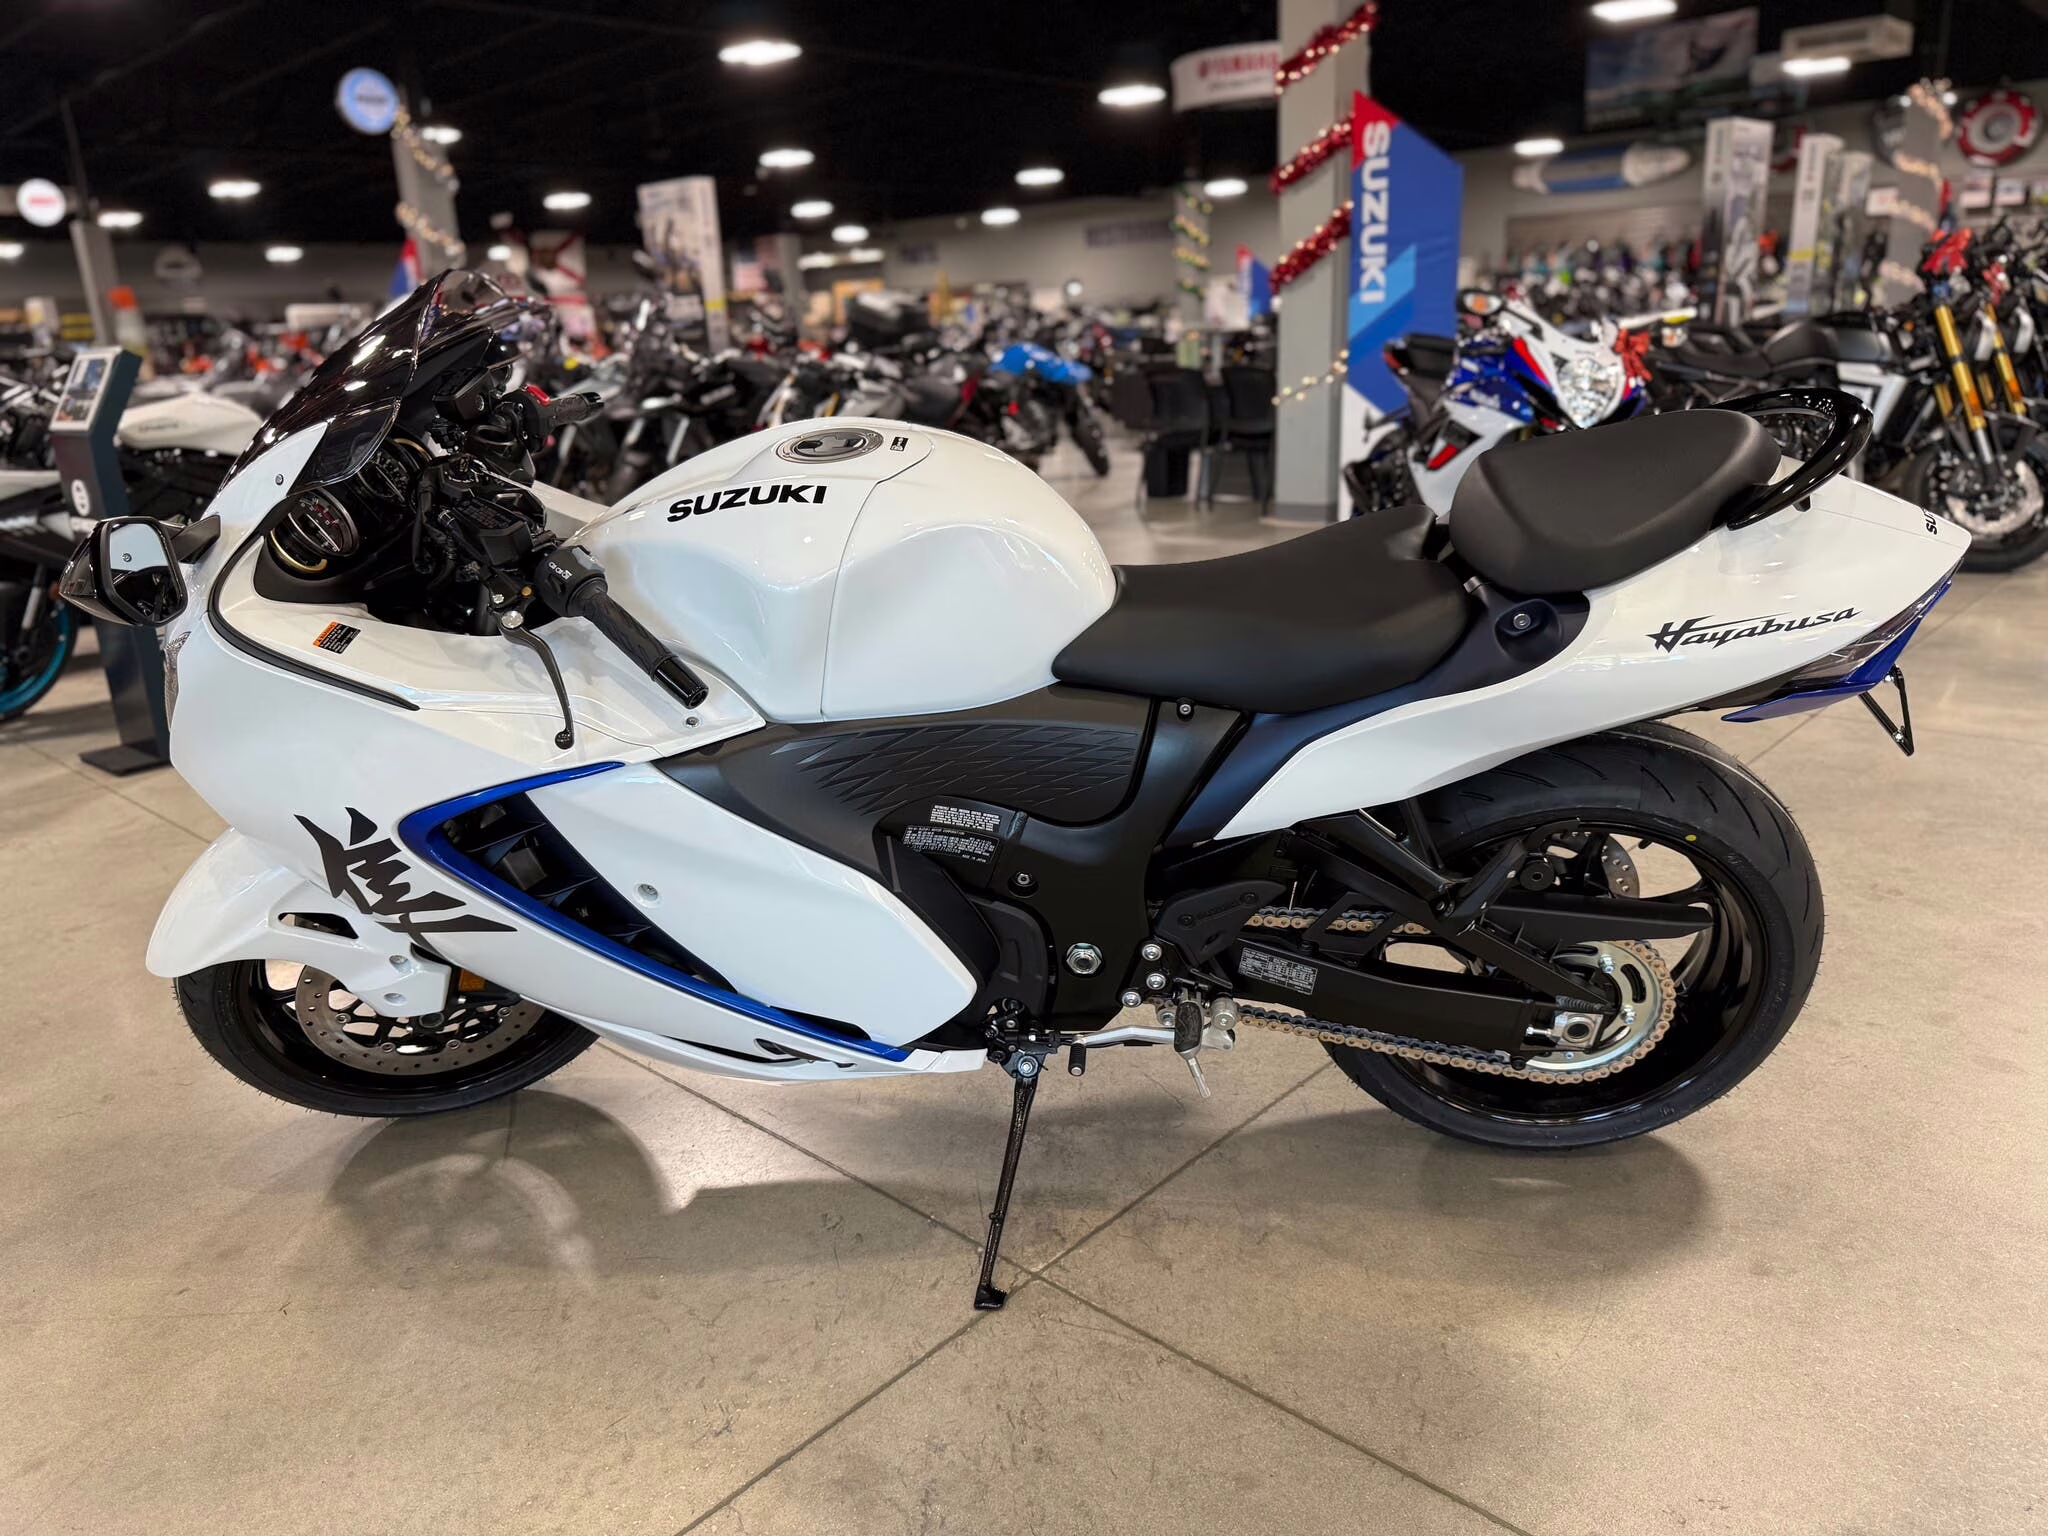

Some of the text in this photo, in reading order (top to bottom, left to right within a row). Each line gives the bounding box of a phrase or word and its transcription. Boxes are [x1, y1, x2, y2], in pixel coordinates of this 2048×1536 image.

[1359, 121, 1390, 304] SUZUKI
[666, 484, 828, 523] SUZUKI
[1924, 513, 1937, 535] SU
[1645, 607, 1864, 653] Hayabusa
